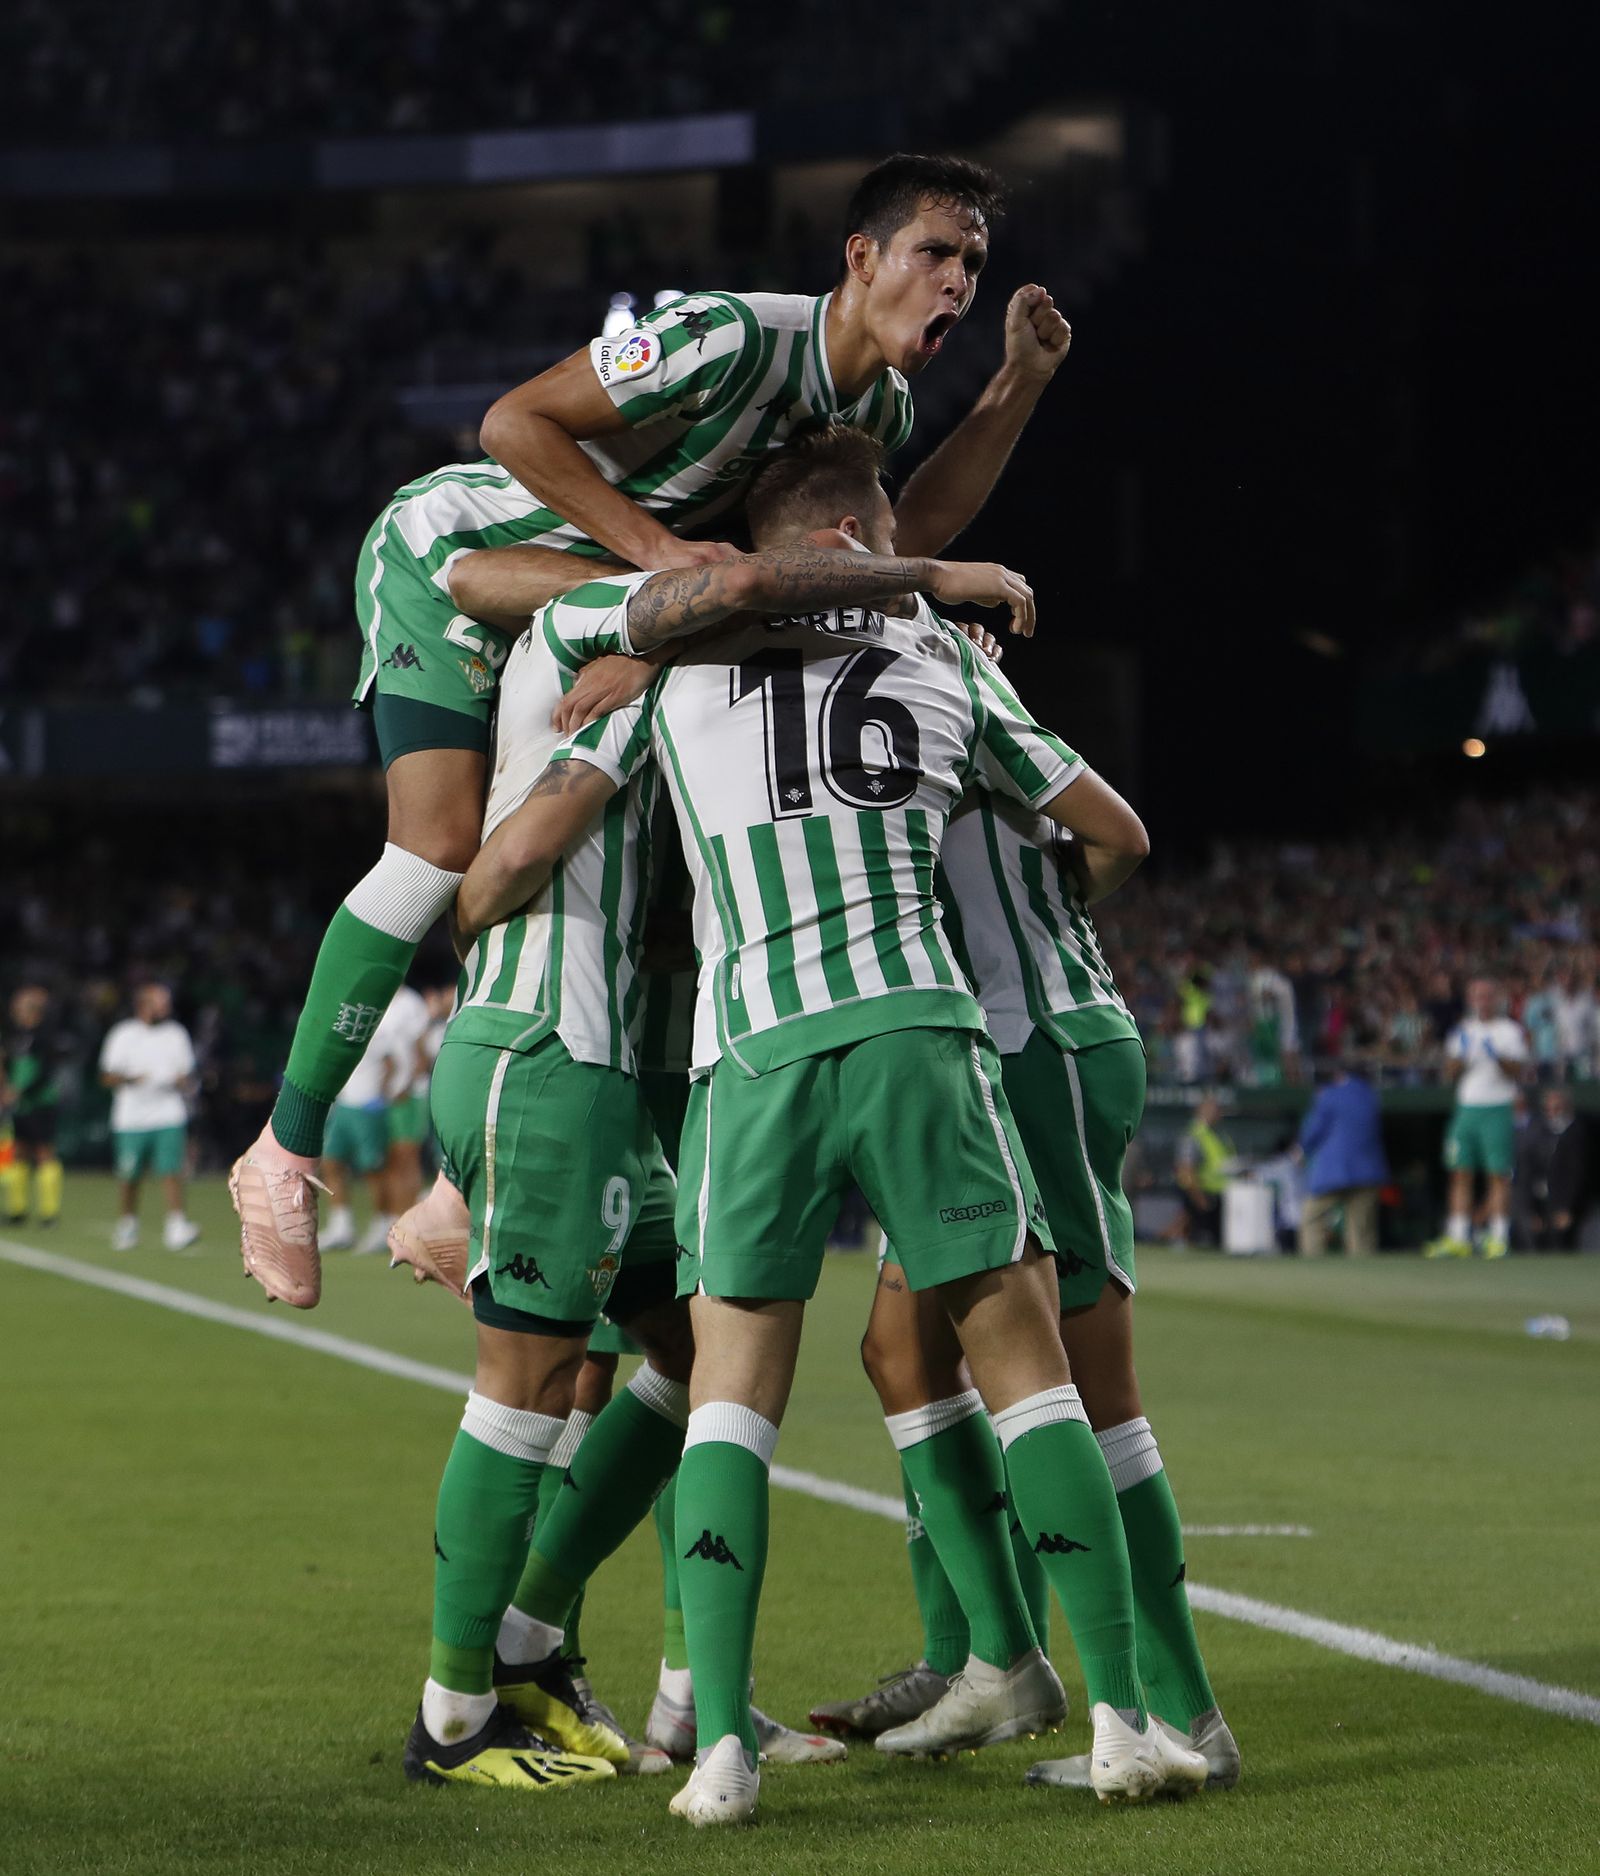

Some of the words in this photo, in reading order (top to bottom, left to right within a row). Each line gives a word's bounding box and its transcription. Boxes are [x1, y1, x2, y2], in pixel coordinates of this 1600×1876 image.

[599, 345, 612, 381] LaLiga
[766, 607, 886, 638] REN
[729, 647, 924, 822] 16
[601, 1175, 631, 1254] 9
[939, 1200, 1008, 1224] Kappa
